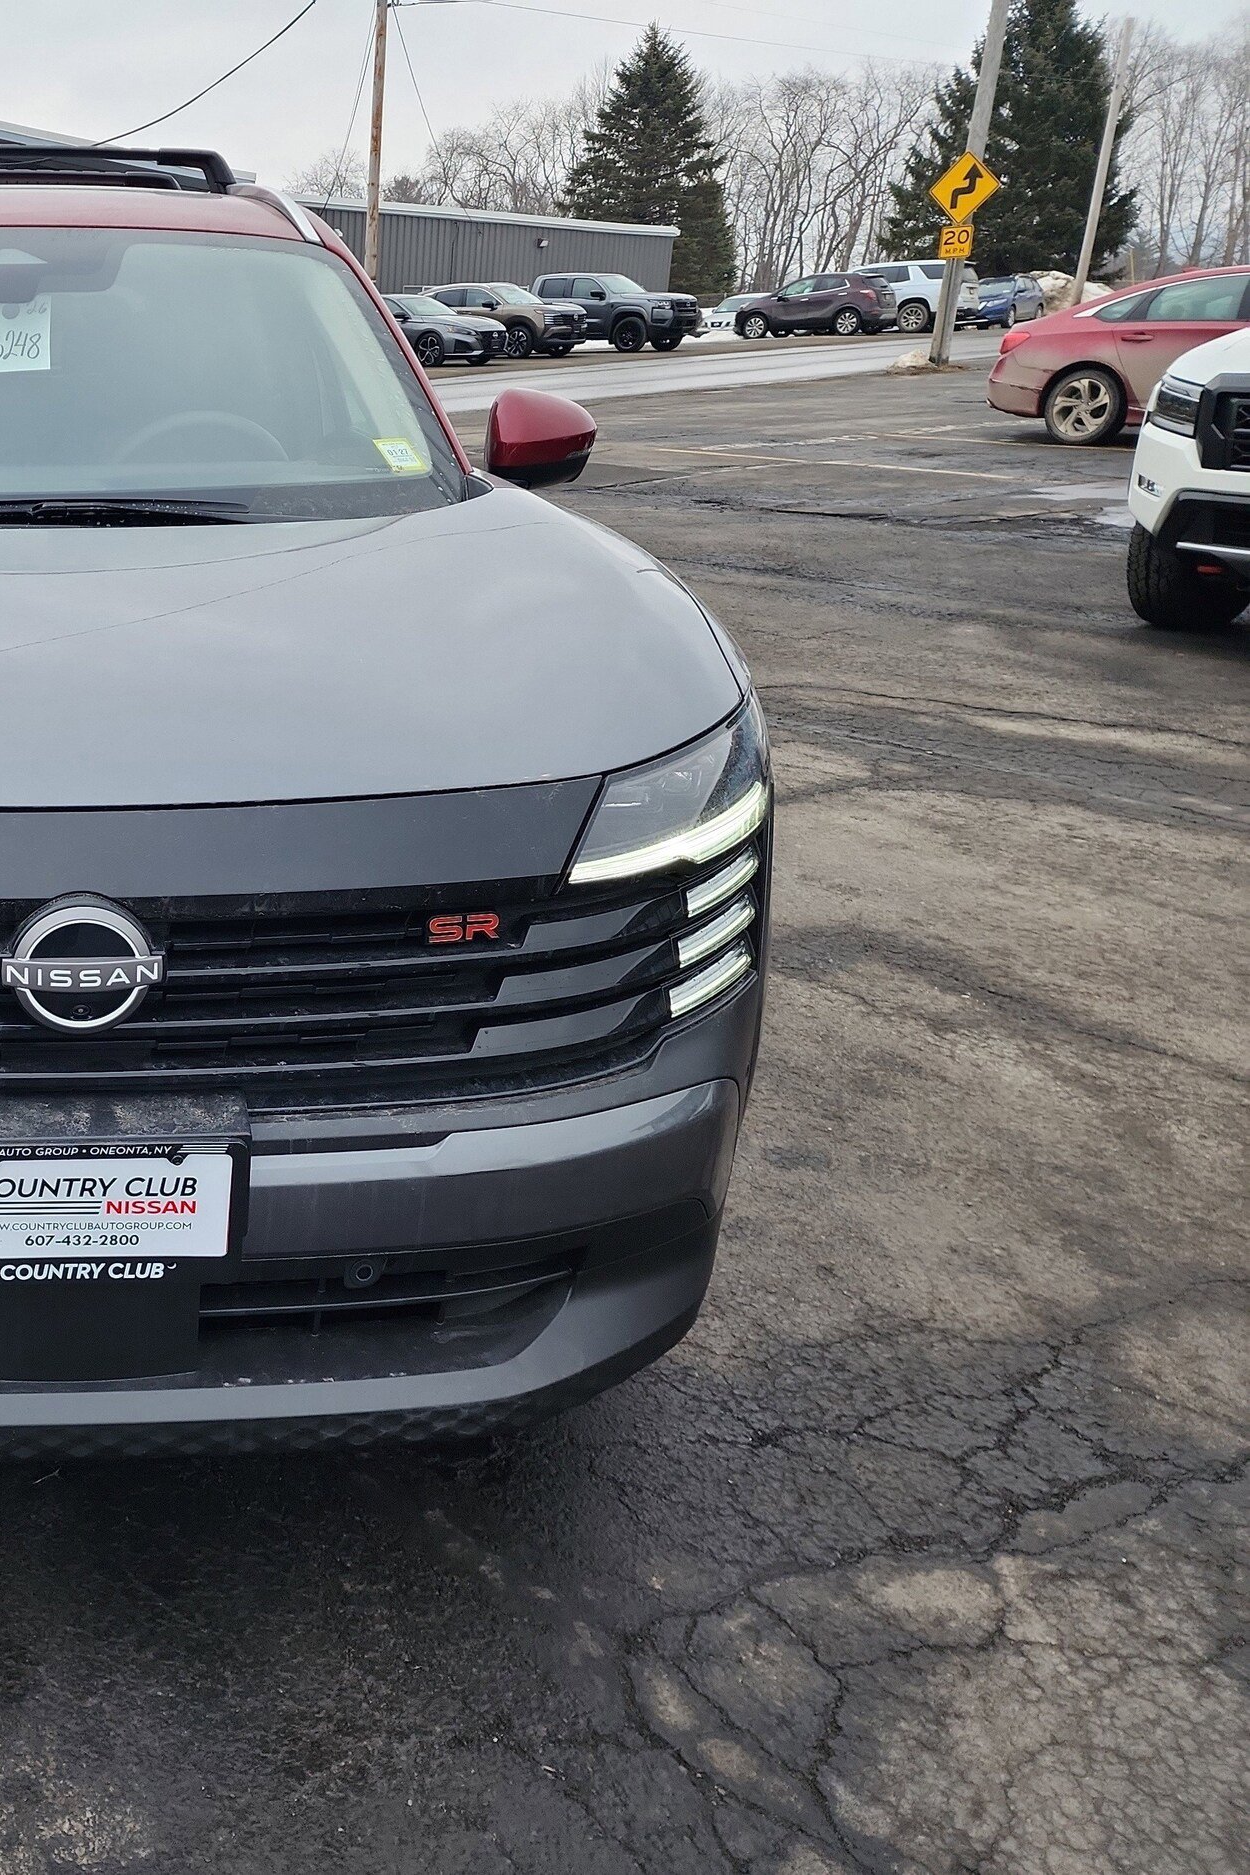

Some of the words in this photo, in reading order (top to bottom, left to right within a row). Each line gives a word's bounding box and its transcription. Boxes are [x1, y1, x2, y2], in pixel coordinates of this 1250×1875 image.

[943, 229, 970, 246] 20
[427, 912, 500, 944] SR
[5, 961, 159, 988] NISSAN
[35, 1146, 79, 1156] GROUP
[124, 1177, 198, 1197] CLUB
[105, 1200, 197, 1215] NISSAN
[24, 1234, 140, 1246] 607-432-2800
[0, 1262, 106, 1281] COUNTRY
[107, 1262, 165, 1279] CLUB
